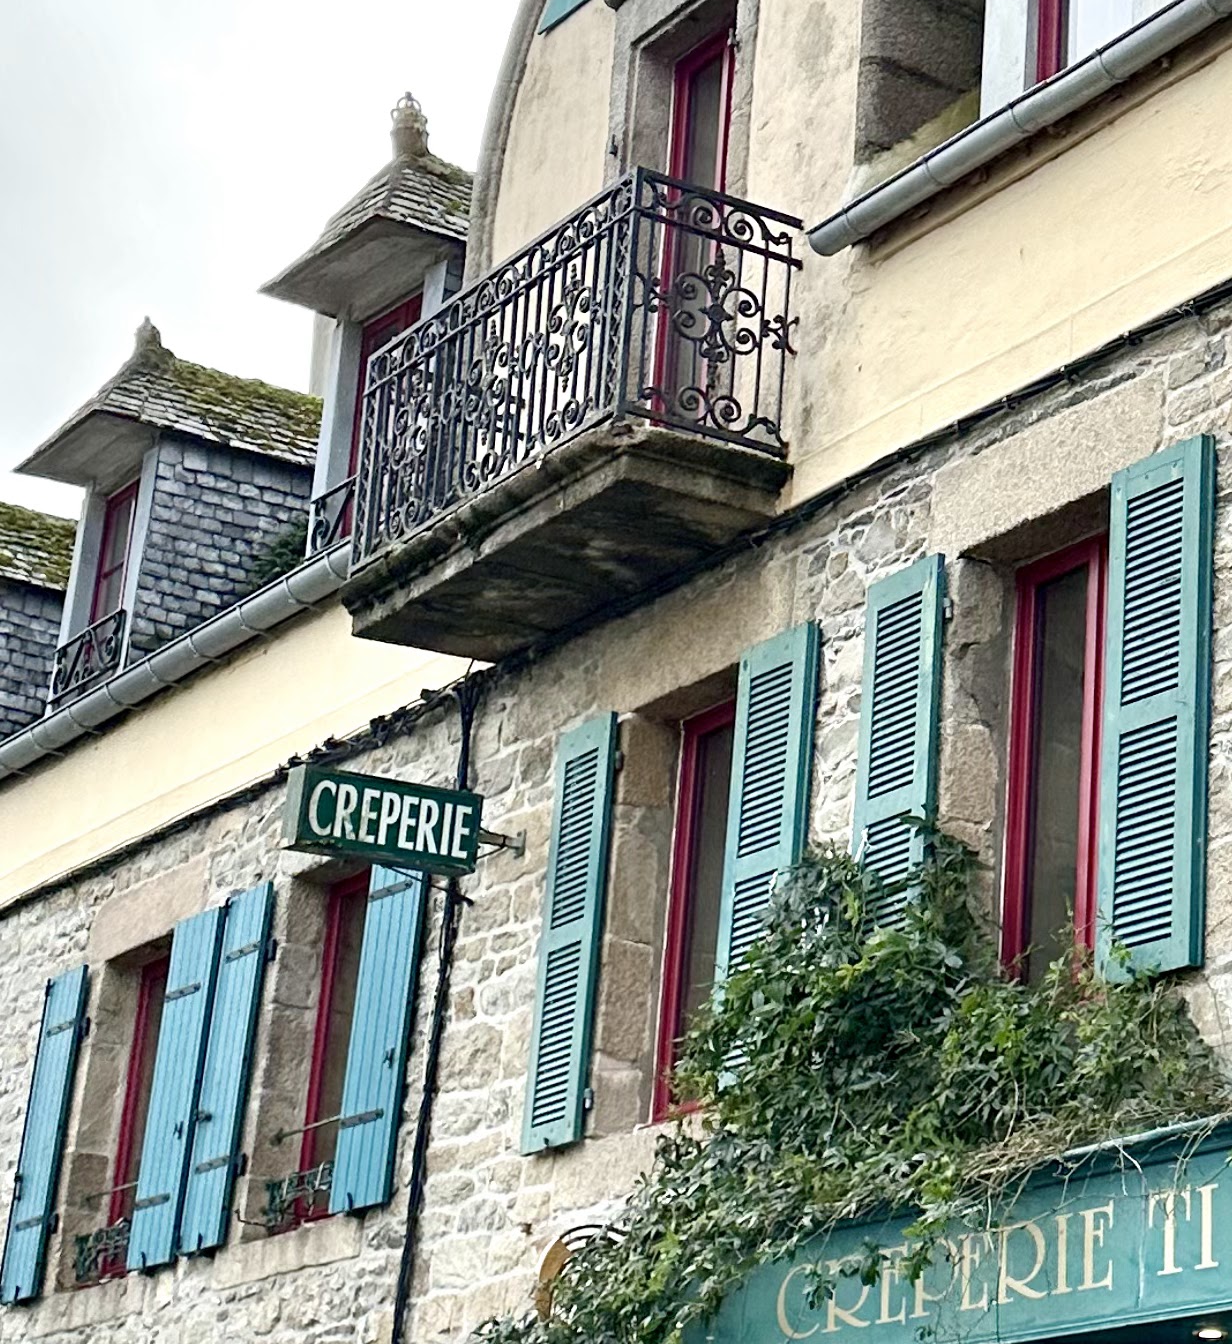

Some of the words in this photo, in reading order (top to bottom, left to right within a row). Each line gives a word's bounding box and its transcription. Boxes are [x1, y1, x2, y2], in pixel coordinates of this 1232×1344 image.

[308, 779, 473, 859] CREPERIE
[776, 1200, 1115, 1339] CREPERIE
[1147, 1183, 1219, 1276] TI
